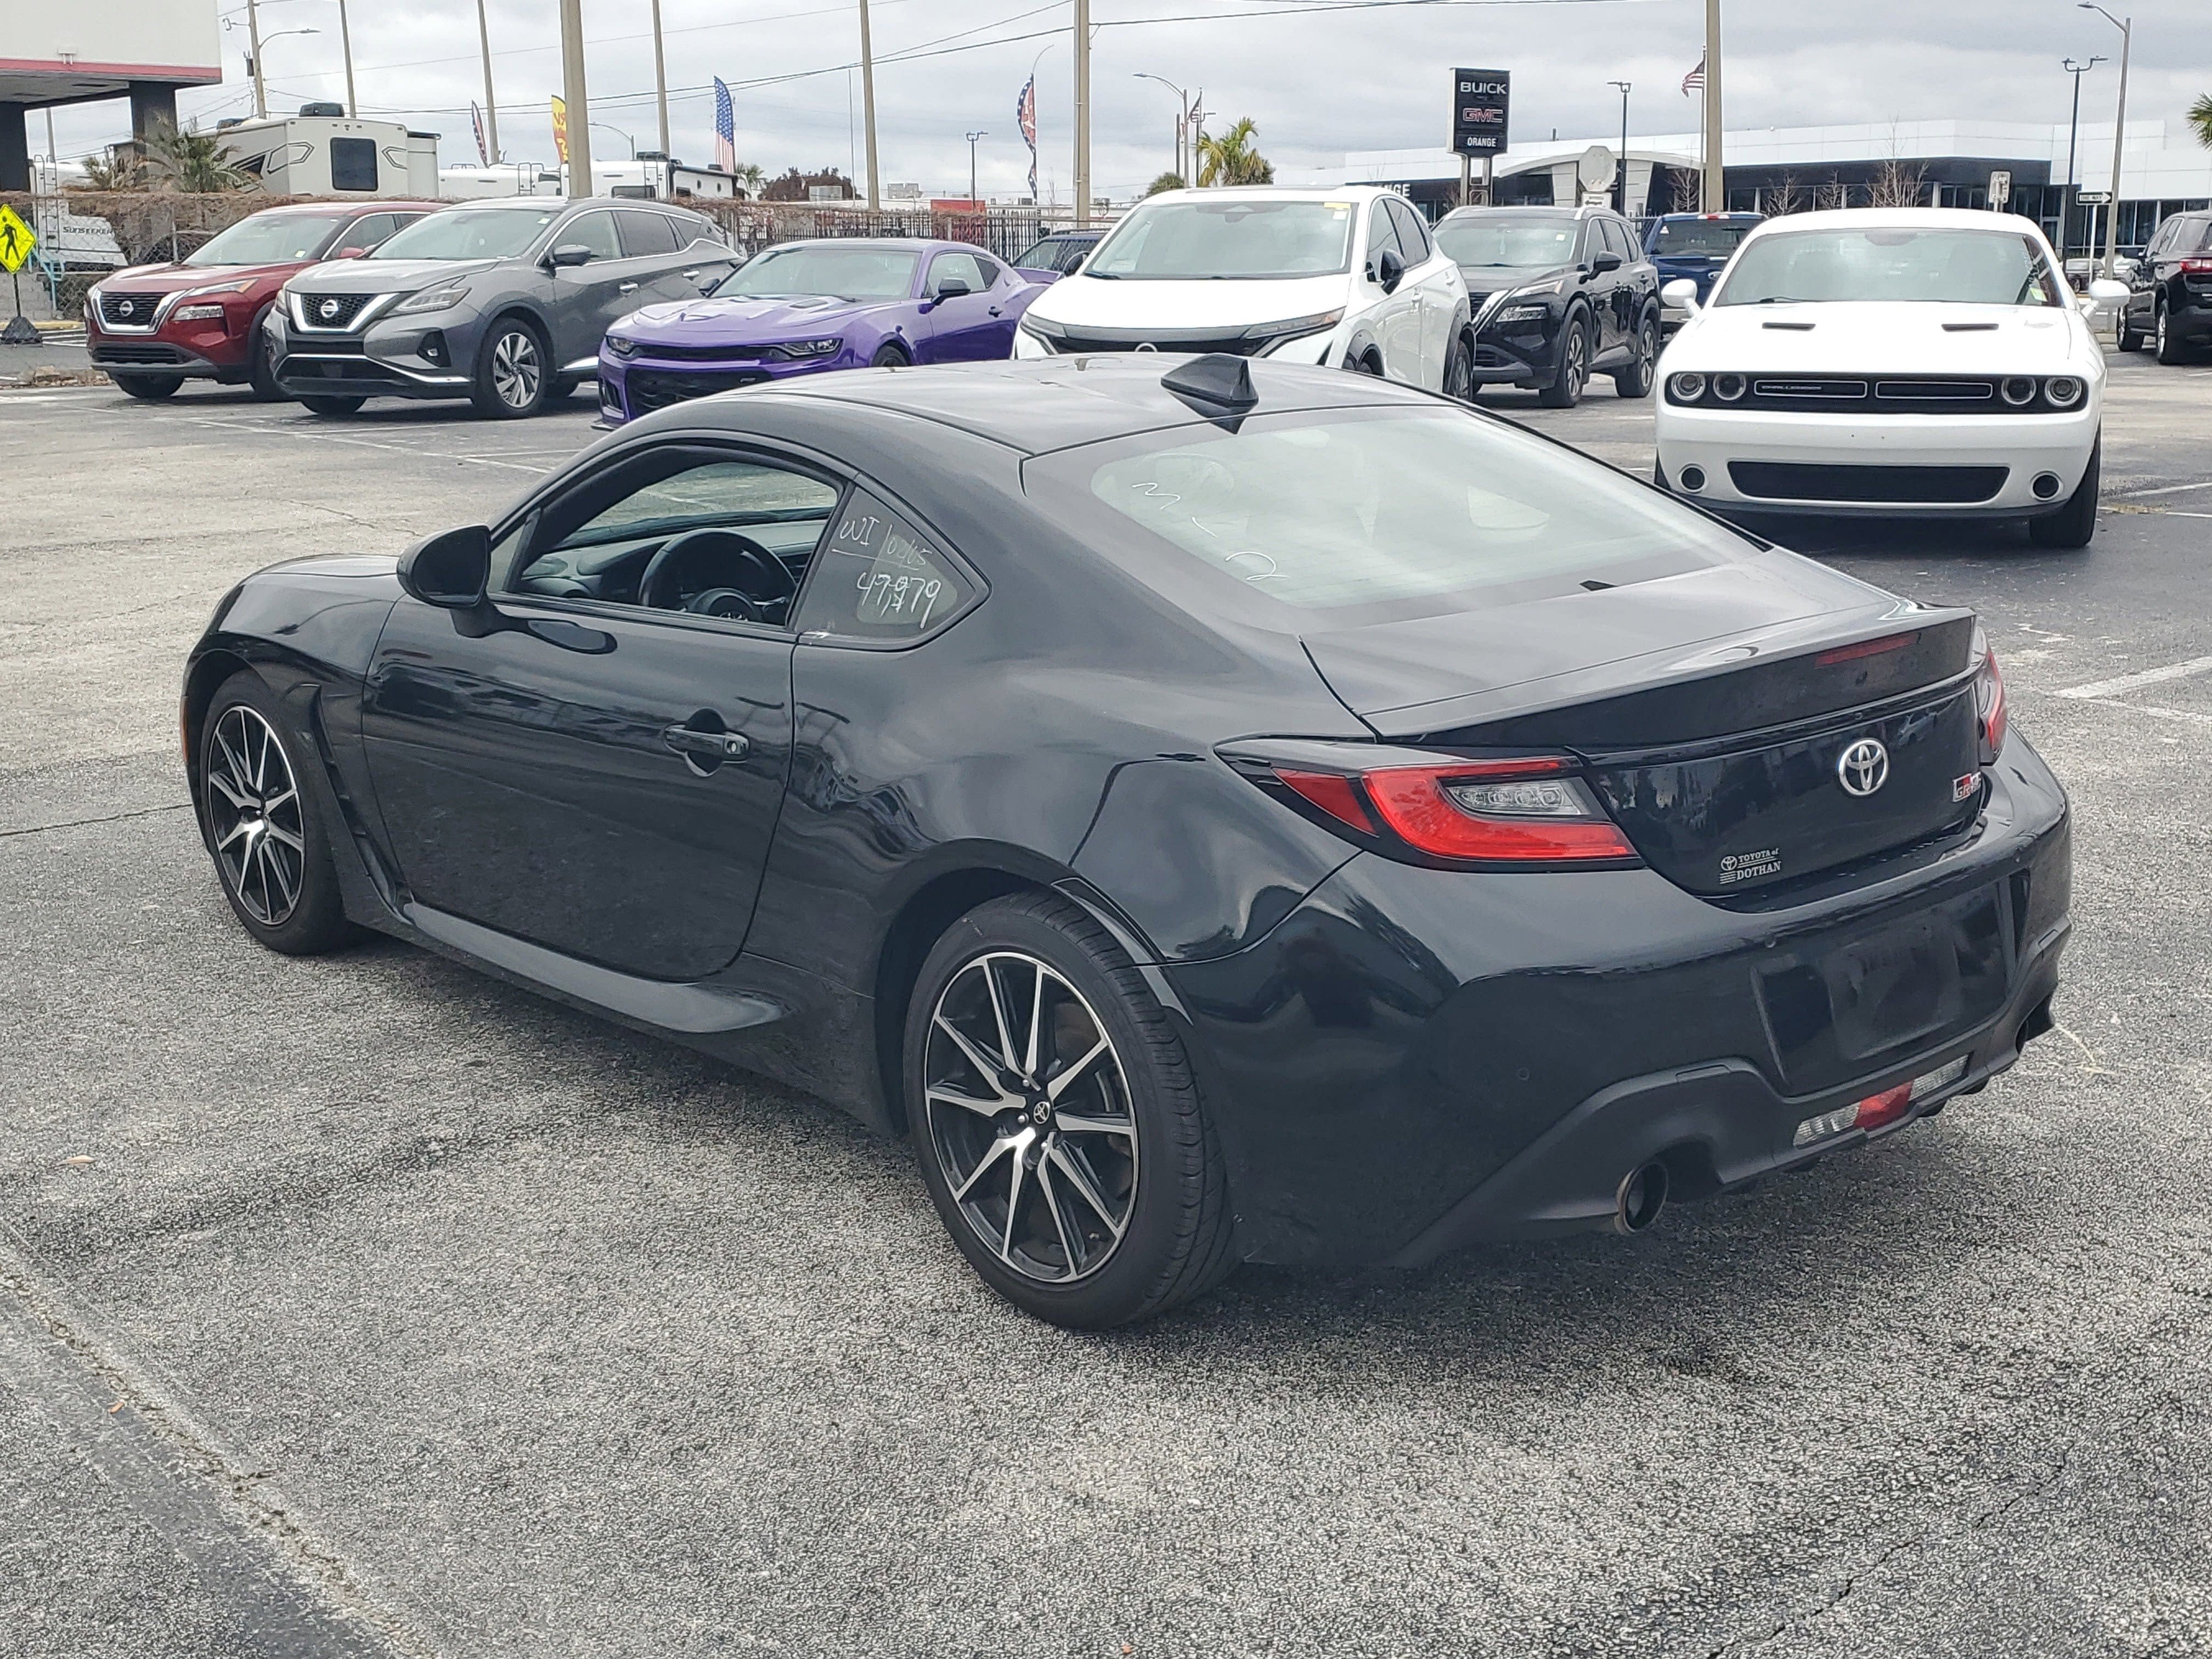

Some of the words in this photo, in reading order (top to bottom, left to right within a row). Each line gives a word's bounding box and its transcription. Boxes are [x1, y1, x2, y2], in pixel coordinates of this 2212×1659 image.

[1460, 81, 1507, 94] BUICK
[1463, 108, 1503, 123] GMC
[1468, 137, 1497, 147] ORANGE
[1738, 849, 1770, 862] TOYOTA
[1736, 861, 1782, 880] DOTHAN
